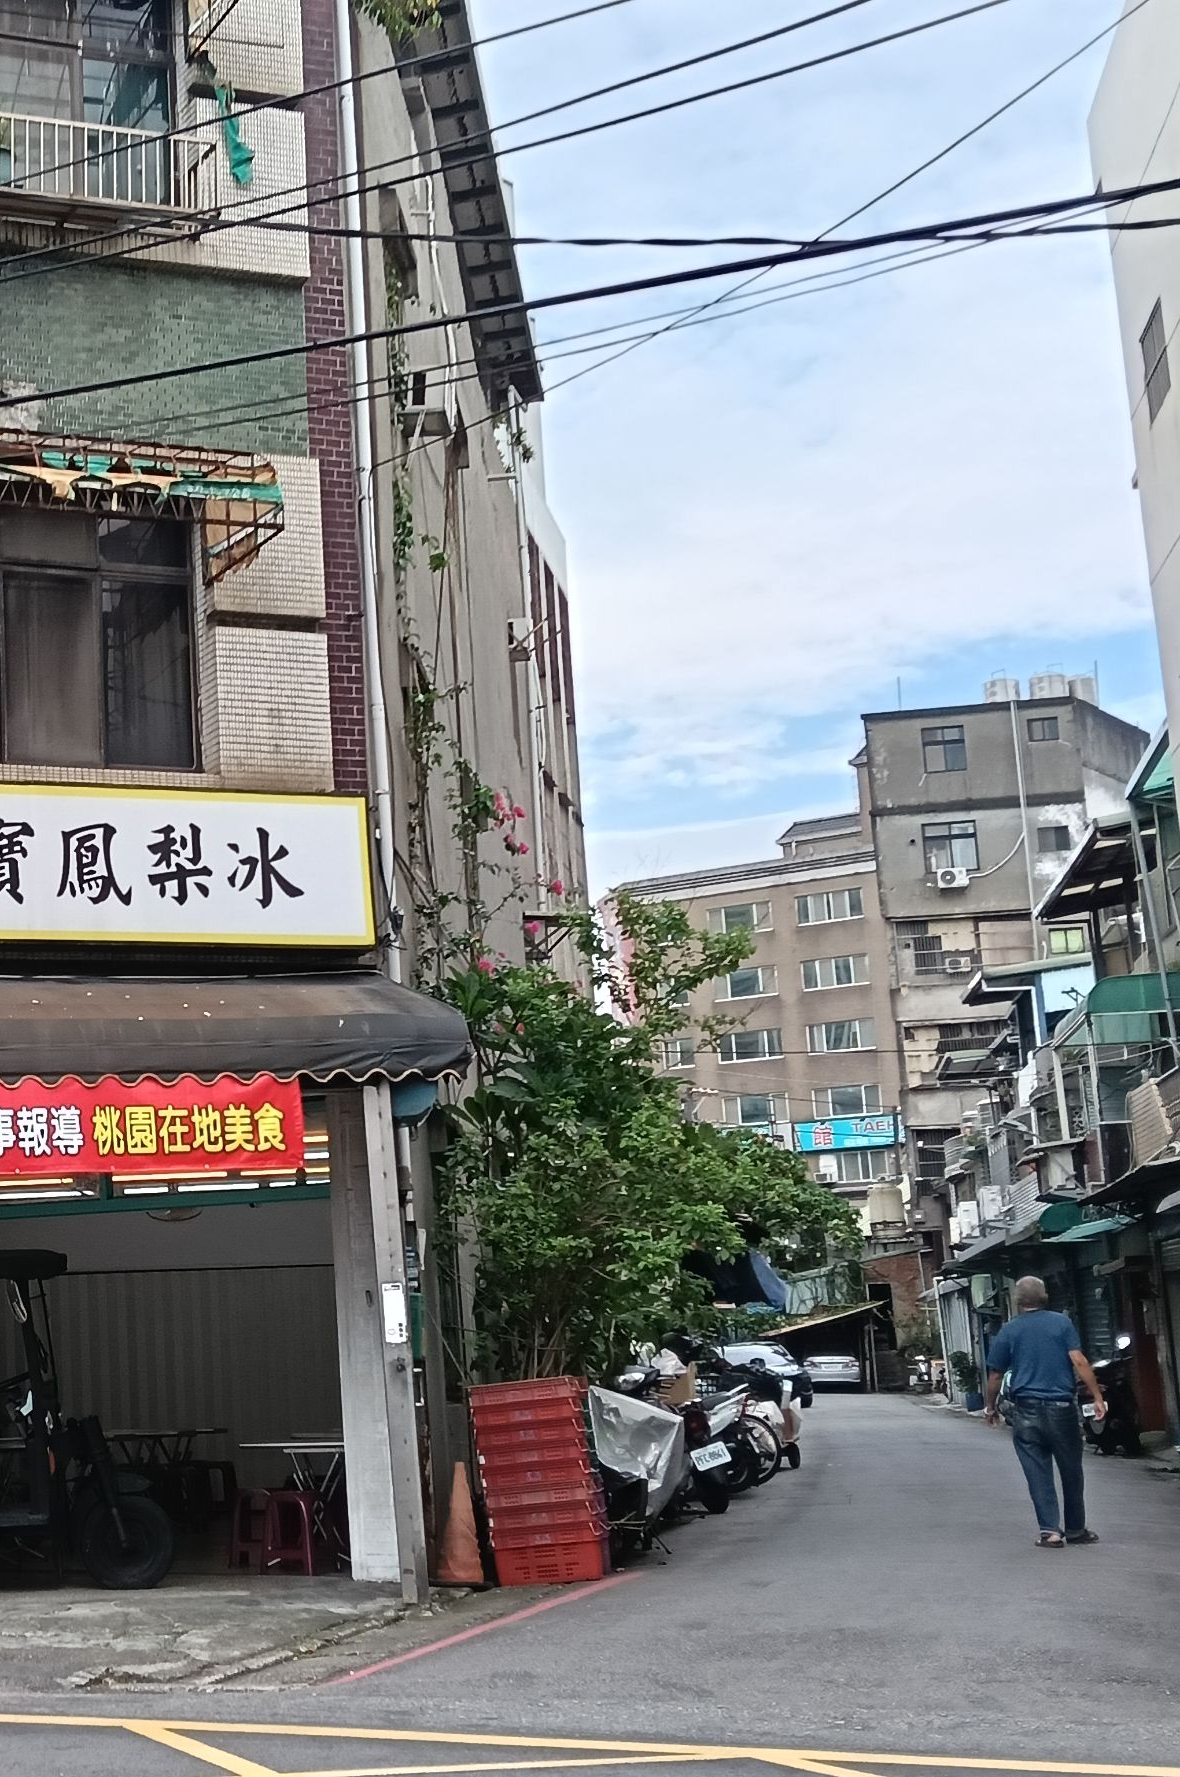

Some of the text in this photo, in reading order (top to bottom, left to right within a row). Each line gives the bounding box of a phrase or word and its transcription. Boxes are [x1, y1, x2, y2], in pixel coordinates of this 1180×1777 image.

[92, 1102, 286, 1156] 桃園在地美食
